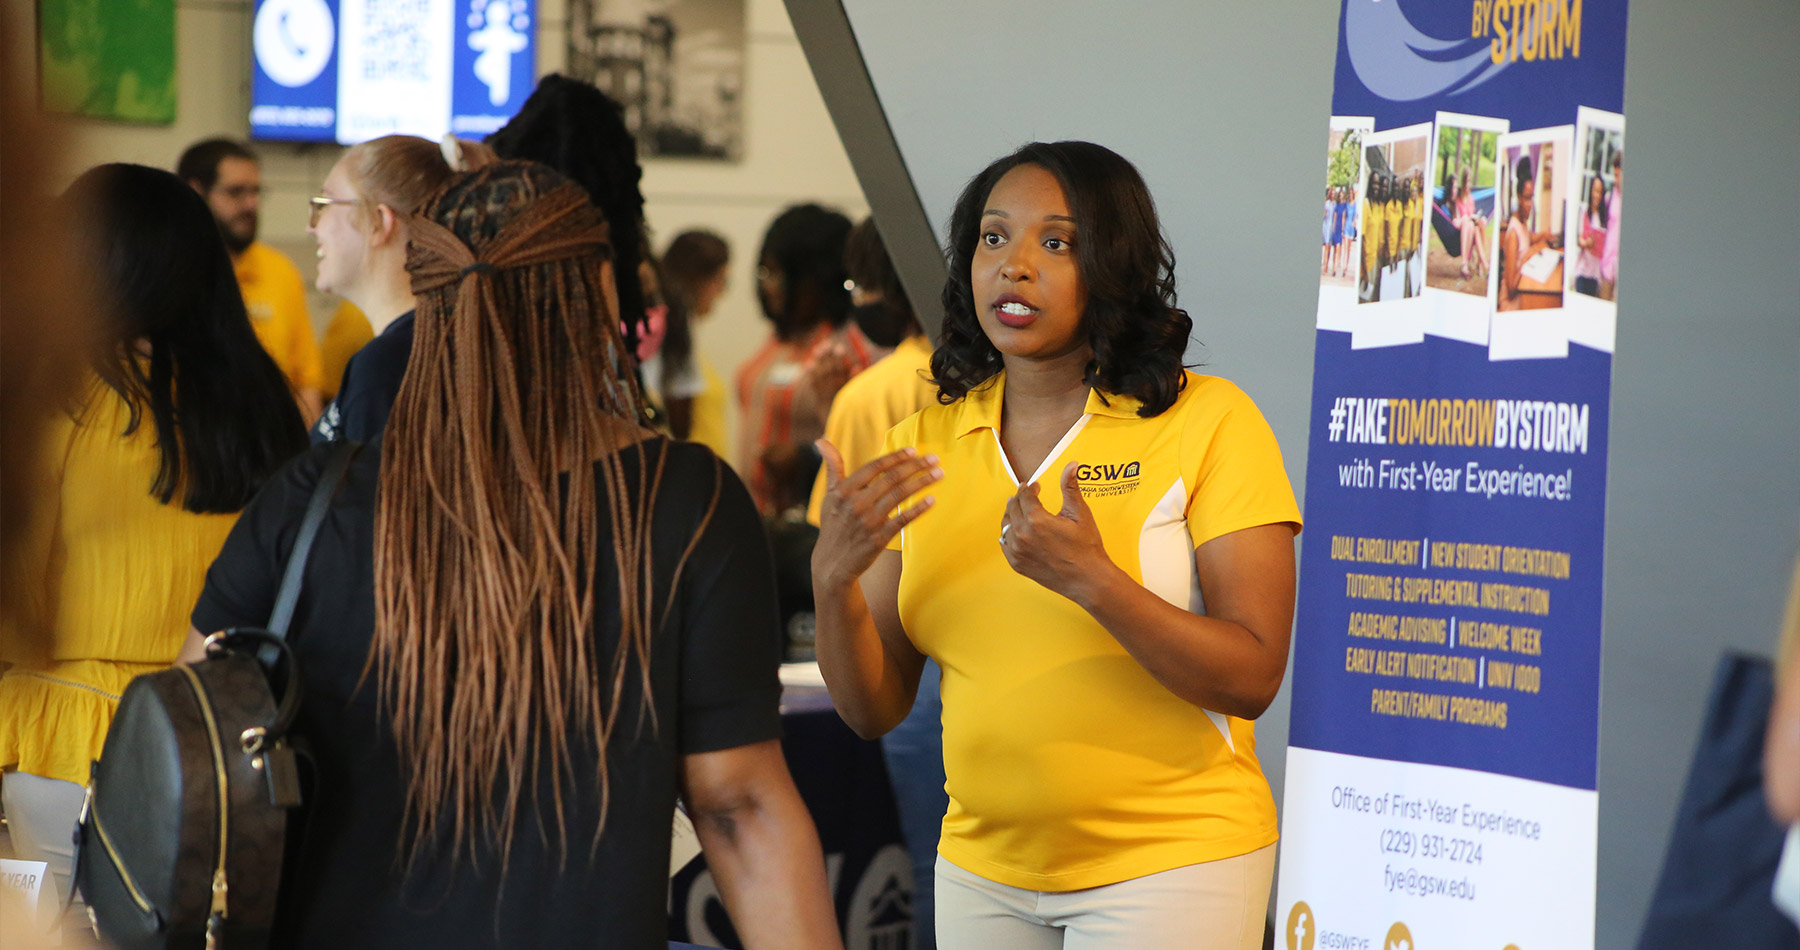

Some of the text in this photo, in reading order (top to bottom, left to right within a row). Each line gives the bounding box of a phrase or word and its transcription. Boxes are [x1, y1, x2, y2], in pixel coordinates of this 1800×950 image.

[1471, 0, 1491, 38] BY
[1491, 0, 1583, 64] STORM
[1328, 397, 1590, 454] #TAKETOMORROWBYSTORM
[1077, 464, 1125, 481] GSW
[1339, 458, 1572, 501] with First-Year Experience!
[1331, 535, 1571, 580] DUAL ENROLLMENT NEW STUDENT ORIENTATION
[1346, 572, 1550, 616] TUTORING & SUPPLEMENTAL INSTRUCTION
[1348, 611, 1542, 656] ACADEMIC ADVISING WELCOME WEEK
[1345, 646, 1541, 694] EARLY ALERT NOTIFICATION UNIV 1000
[1371, 688, 1508, 729] PARENT/FAMILY PROGRAMS
[1332, 786, 1541, 841] Office of First-Year Experience
[1380, 829, 1483, 866] (229) 931-2724
[8, 872, 37, 890] YEAR
[1385, 864, 1476, 901] fye@gsw.edu
